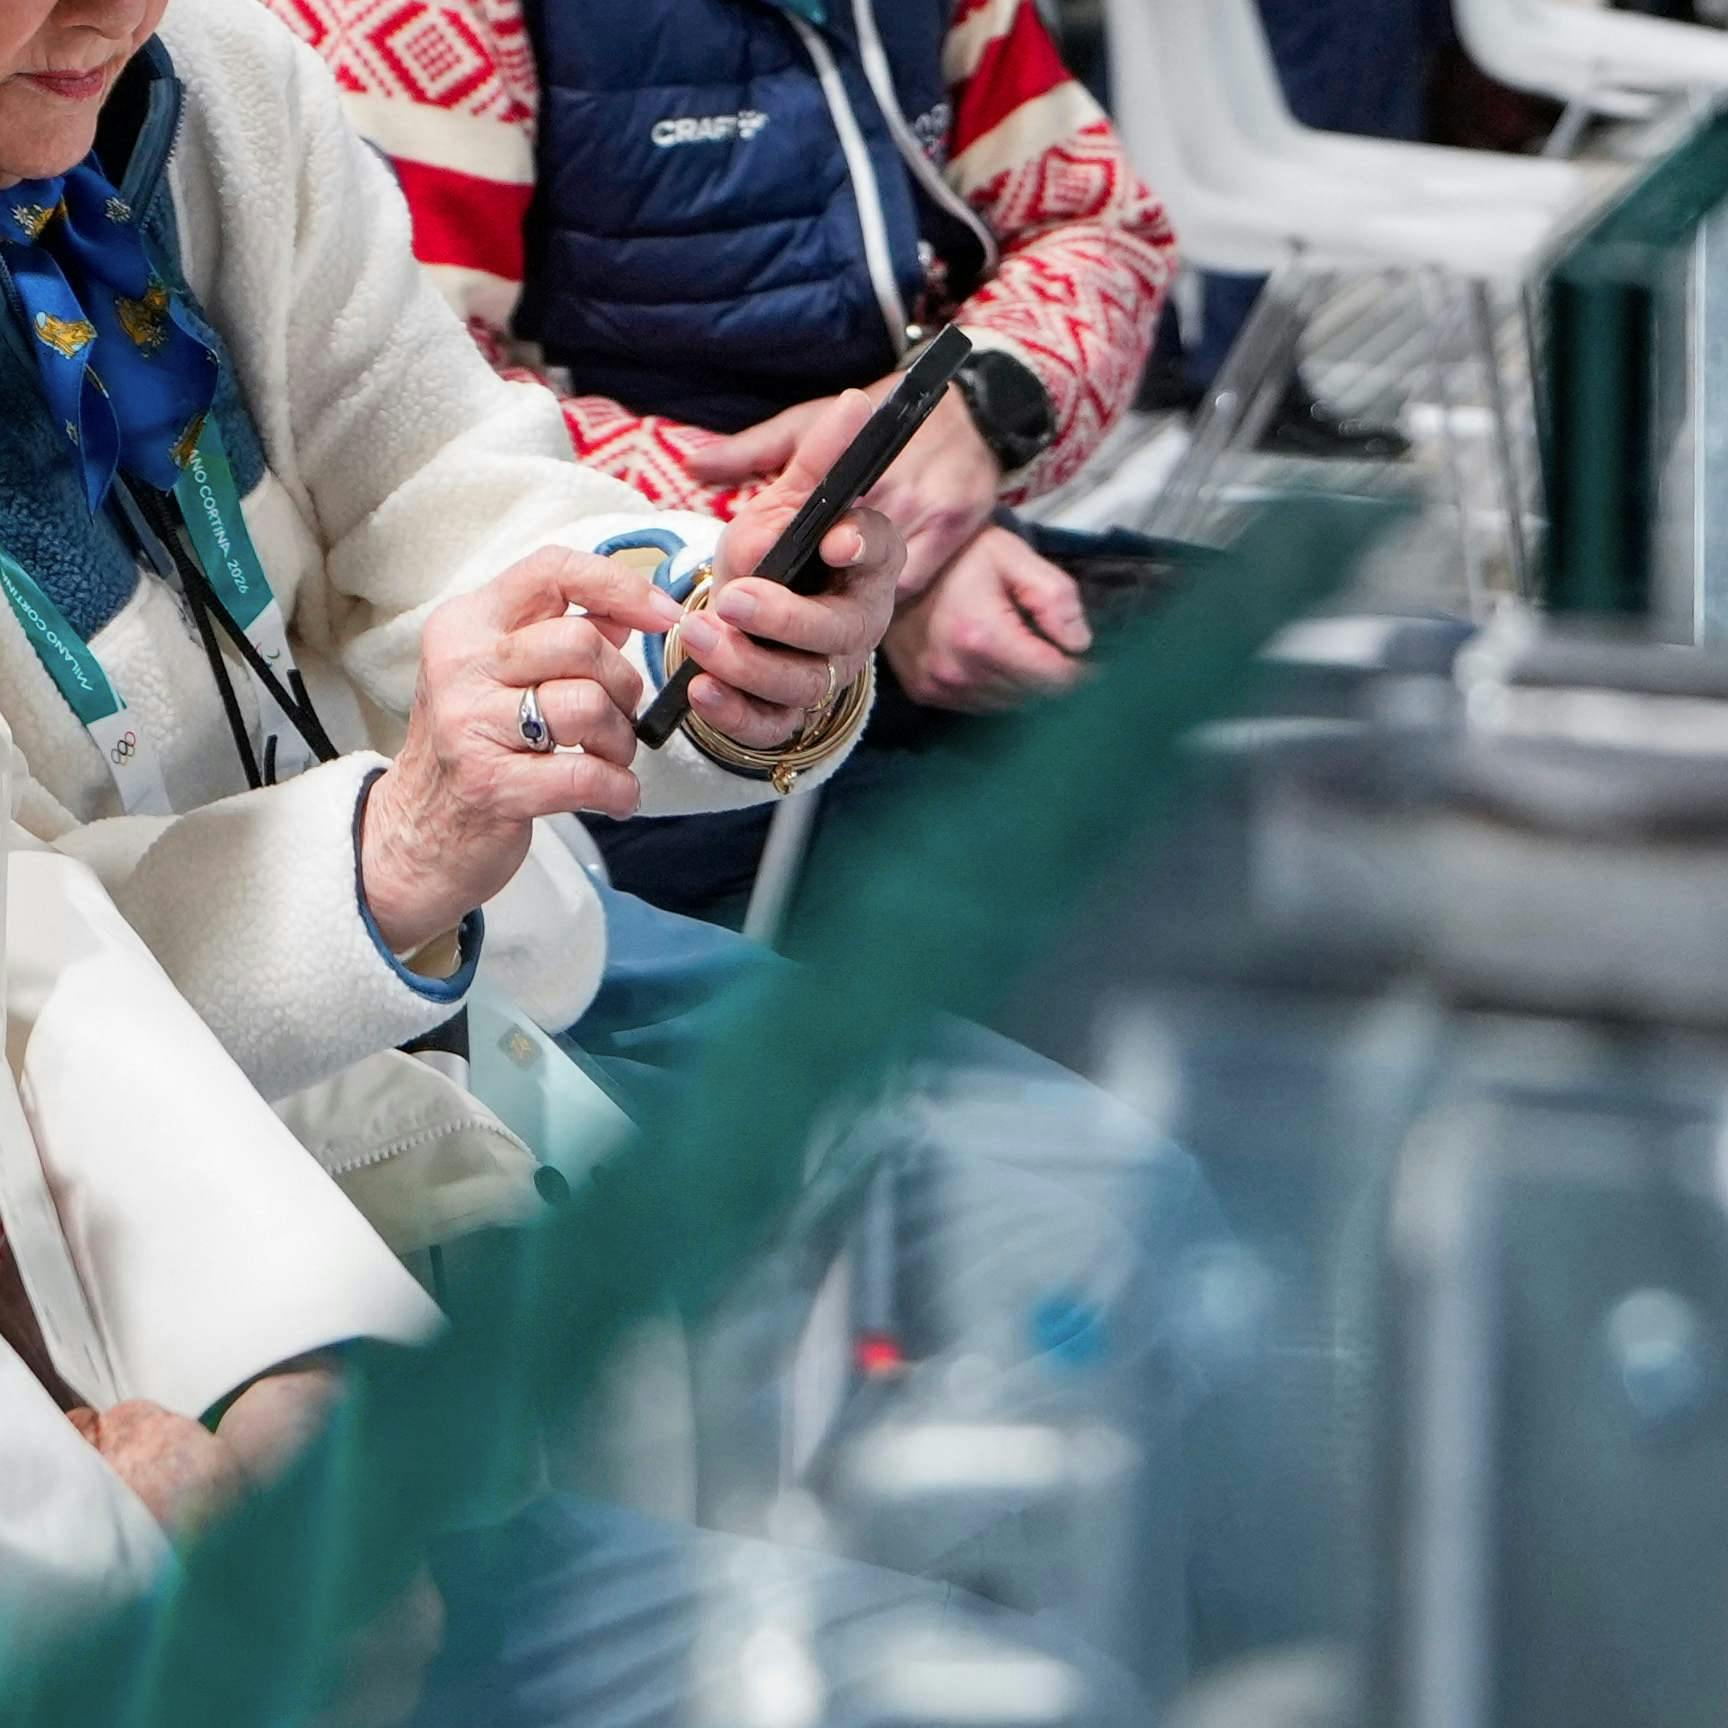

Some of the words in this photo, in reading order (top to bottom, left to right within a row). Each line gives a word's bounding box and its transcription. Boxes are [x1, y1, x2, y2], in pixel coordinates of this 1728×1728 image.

[199, 485, 232, 558] CORTINA
[226, 559, 249, 594] 2026
[46, 630, 94, 691] MILANO
